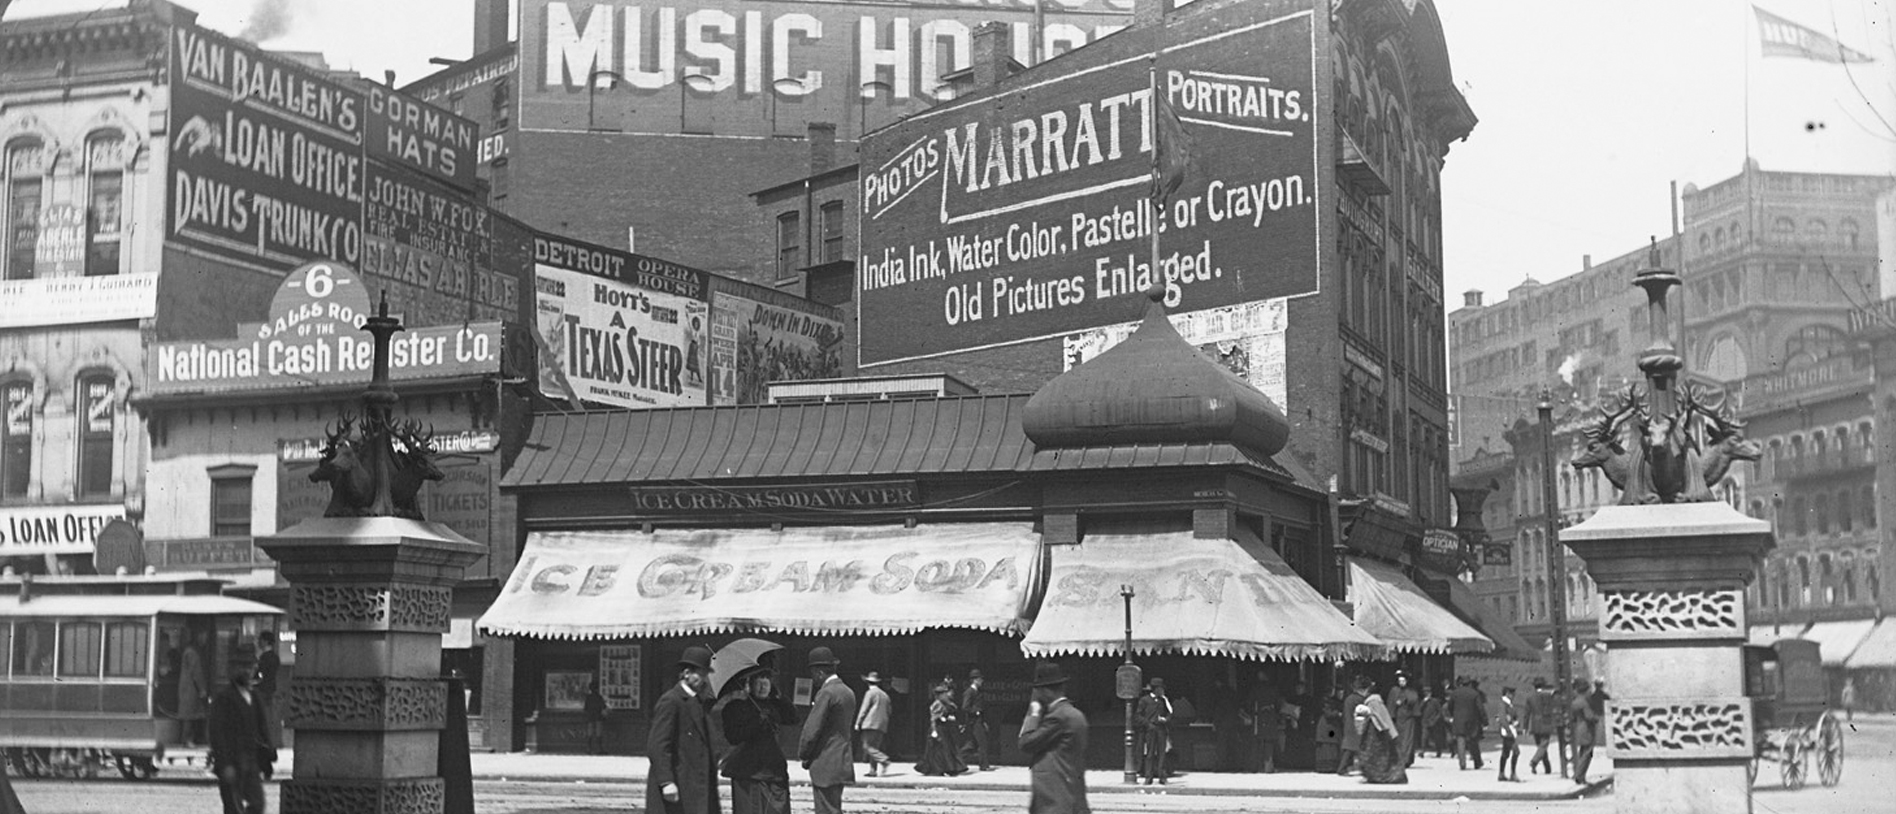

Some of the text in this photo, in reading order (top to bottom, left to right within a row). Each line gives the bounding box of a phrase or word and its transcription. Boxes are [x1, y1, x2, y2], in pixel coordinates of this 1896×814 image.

[177, 28, 225, 85] VAN
[543, 2, 821, 95] MUSIC
[1166, 70, 1310, 122] PORTRAITS.
[369, 86, 472, 151] GORMAN
[224, 109, 362, 204] LOAN OFFICE.
[387, 124, 456, 178] HATS
[942, 86, 1153, 194] MARRATT
[369, 176, 426, 217] JOHN
[864, 138, 939, 214] PHOTOS
[174, 168, 249, 236] DAVIS
[252, 193, 330, 257] TRUNK
[367, 203, 411, 230] REAL
[370, 219, 396, 239] FIRE
[862, 253, 904, 292] India
[909, 246, 946, 281] Ink,
[945, 234, 1003, 276] Water
[1006, 224, 1067, 263] Color,
[1174, 196, 1201, 229] or
[1206, 173, 1313, 227] Crayon.
[364, 240, 431, 290] ELIAS
[535, 238, 625, 277] DETROIT
[637, 258, 700, 285] OPERA
[305, 265, 334, 298] 6
[593, 282, 650, 314] HOYT'S
[637, 272, 700, 299] HOUSE
[945, 285, 982, 325] Old
[992, 277, 1085, 318] Pictures
[258, 302, 323, 339] SALES
[328, 302, 368, 329] ROO
[298, 323, 335, 336] OF THE
[608, 310, 627, 330] A
[752, 303, 787, 330] DOWN
[787, 312, 801, 334] IN
[801, 315, 830, 338] DIX
[157, 327, 495, 382] National Cash Reister Co.
[564, 313, 683, 396] TEXAS STEER
[432, 492, 487, 512] TICKETS
[634, 480, 916, 510] ICE CREAM SODA WATER
[9, 517, 58, 544] LOAN
[1423, 536, 1458, 551] OPTICIAN
[508, 550, 1020, 600] ICE CREAM SODA
